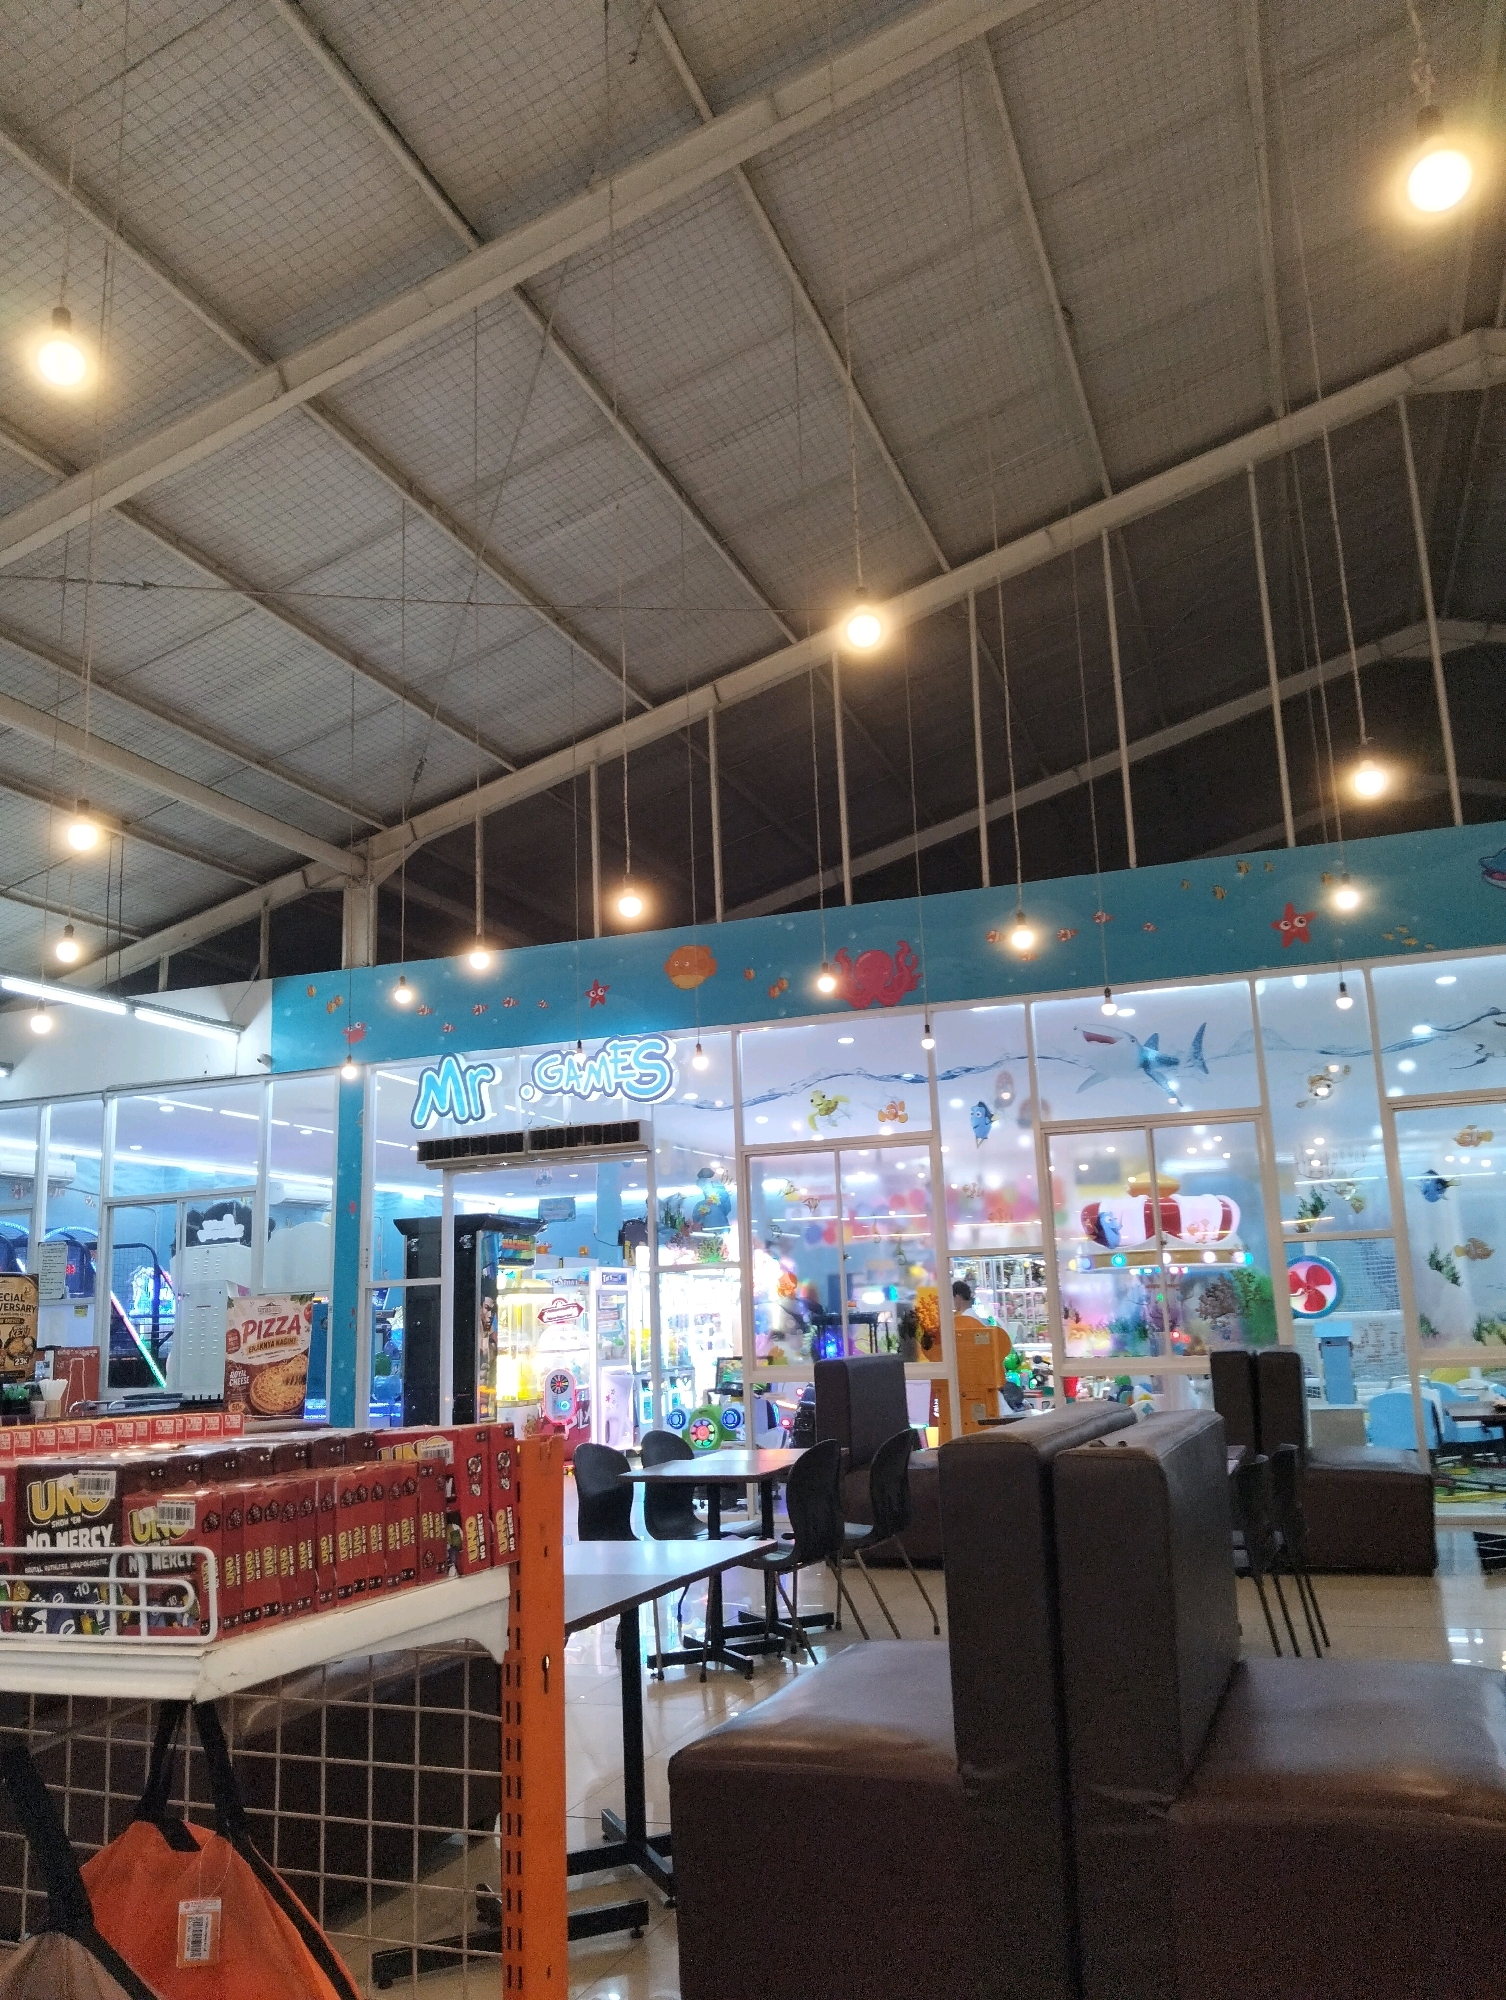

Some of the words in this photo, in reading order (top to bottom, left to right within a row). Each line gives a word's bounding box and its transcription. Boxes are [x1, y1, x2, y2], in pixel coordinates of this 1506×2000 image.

[411, 1053, 495, 1129] Mr
[241, 1314, 302, 1345] PIZZA
[229, 1369, 247, 1379] ROYAL
[229, 1376, 250, 1386] CHEESE
[51, 1518, 69, 1528] SHOW
[495, 1509, 509, 1555] UNO
[506, 1507, 514, 1535] MERCY
[26, 1531, 51, 1548] NO
[56, 1524, 113, 1548] MERCY
[465, 1516, 479, 1563] UNO
[509, 1537, 516, 1551] NO
[128, 1553, 148, 1573] N
[245, 1551, 255, 1582] UNO
[263, 1546, 274, 1577] UNO
[280, 1548, 289, 1577] UNO
[299, 1541, 308, 1571] UNO
[480, 1545, 486, 1559] NO
[225, 1557, 235, 1588] UNO
